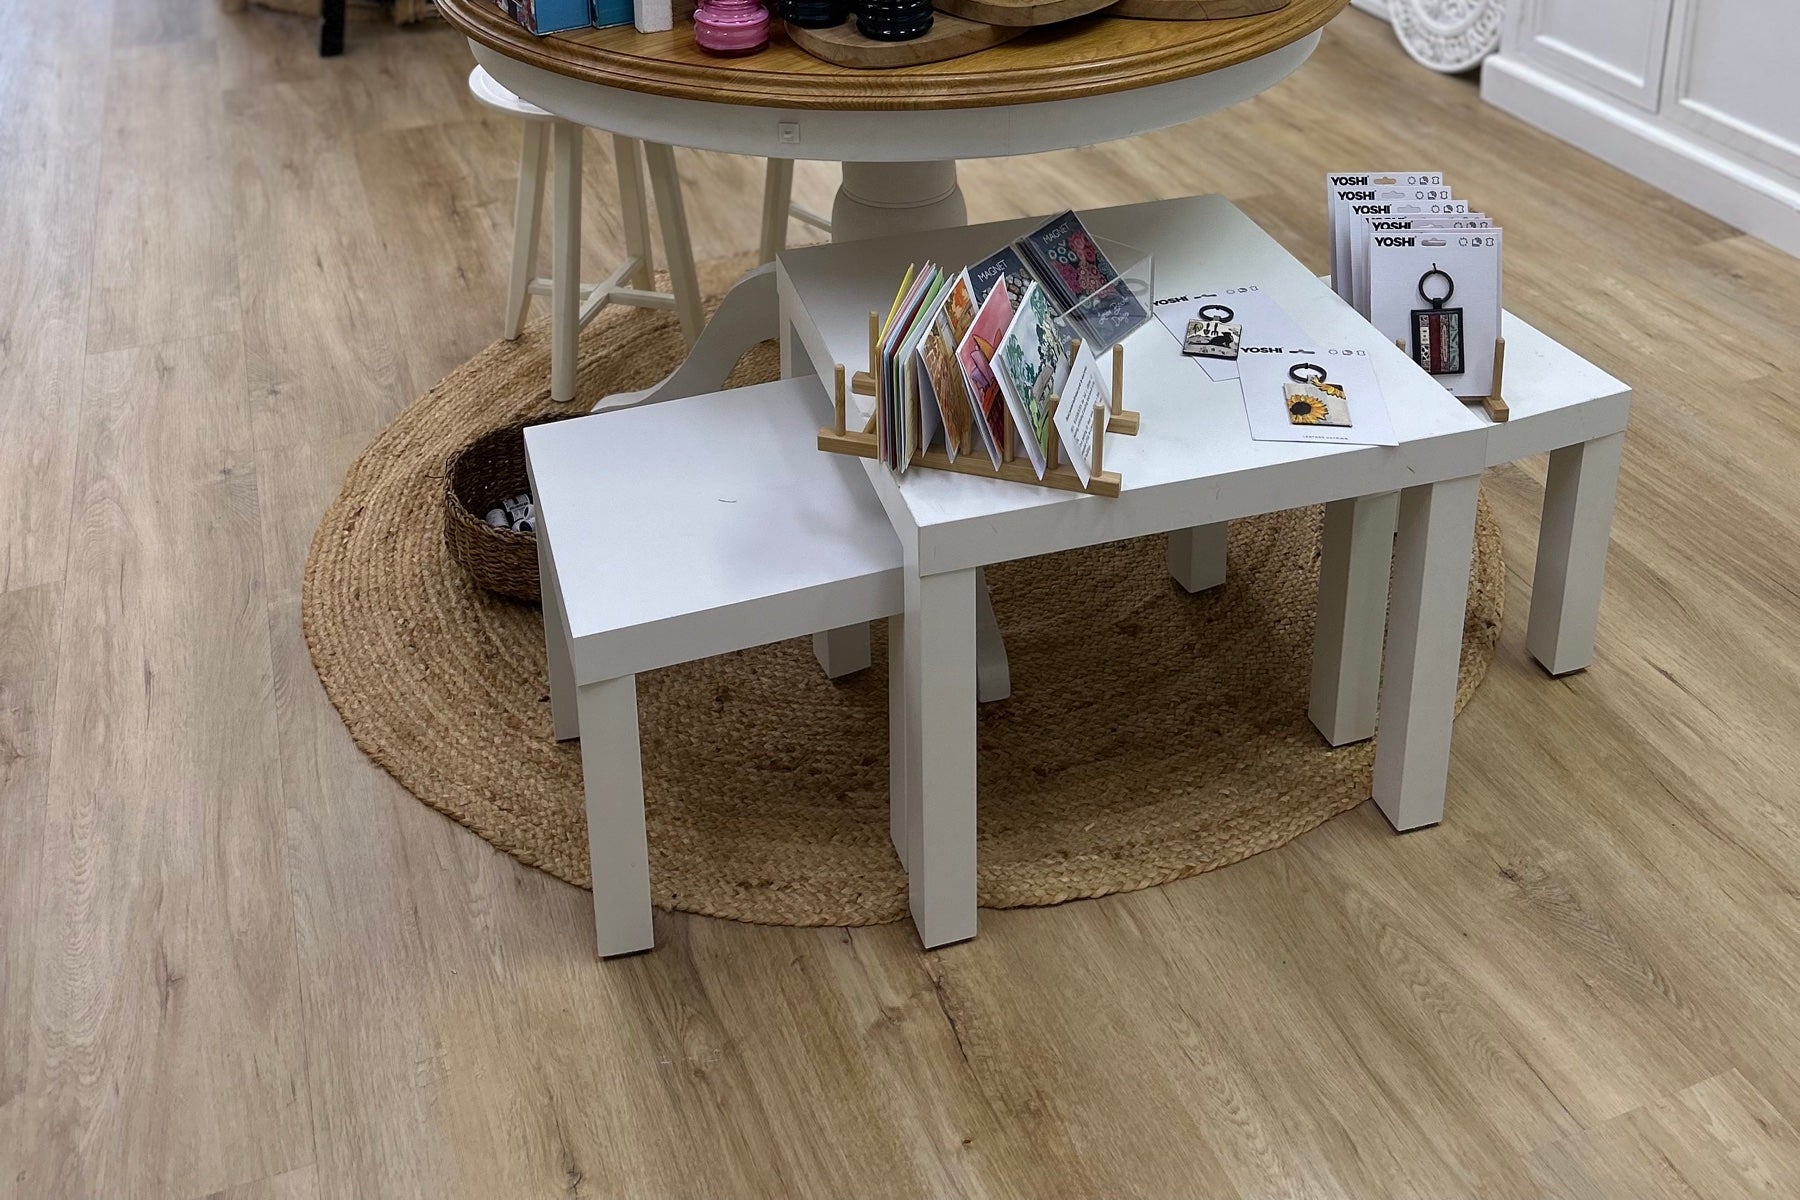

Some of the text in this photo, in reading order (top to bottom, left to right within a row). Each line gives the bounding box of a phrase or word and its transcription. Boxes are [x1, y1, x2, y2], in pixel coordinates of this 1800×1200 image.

[1331, 176, 1368, 185] YOSHI
[1337, 191, 1376, 200] YOSHI
[1352, 205, 1391, 214] YOSHI
[1372, 221, 1413, 229] YOSHI
[1043, 221, 1070, 244] MAGNET
[1375, 236, 1416, 247] YOSHI
[977, 259, 1008, 282] MAGNET
[1153, 295, 1188, 306] YOSHI
